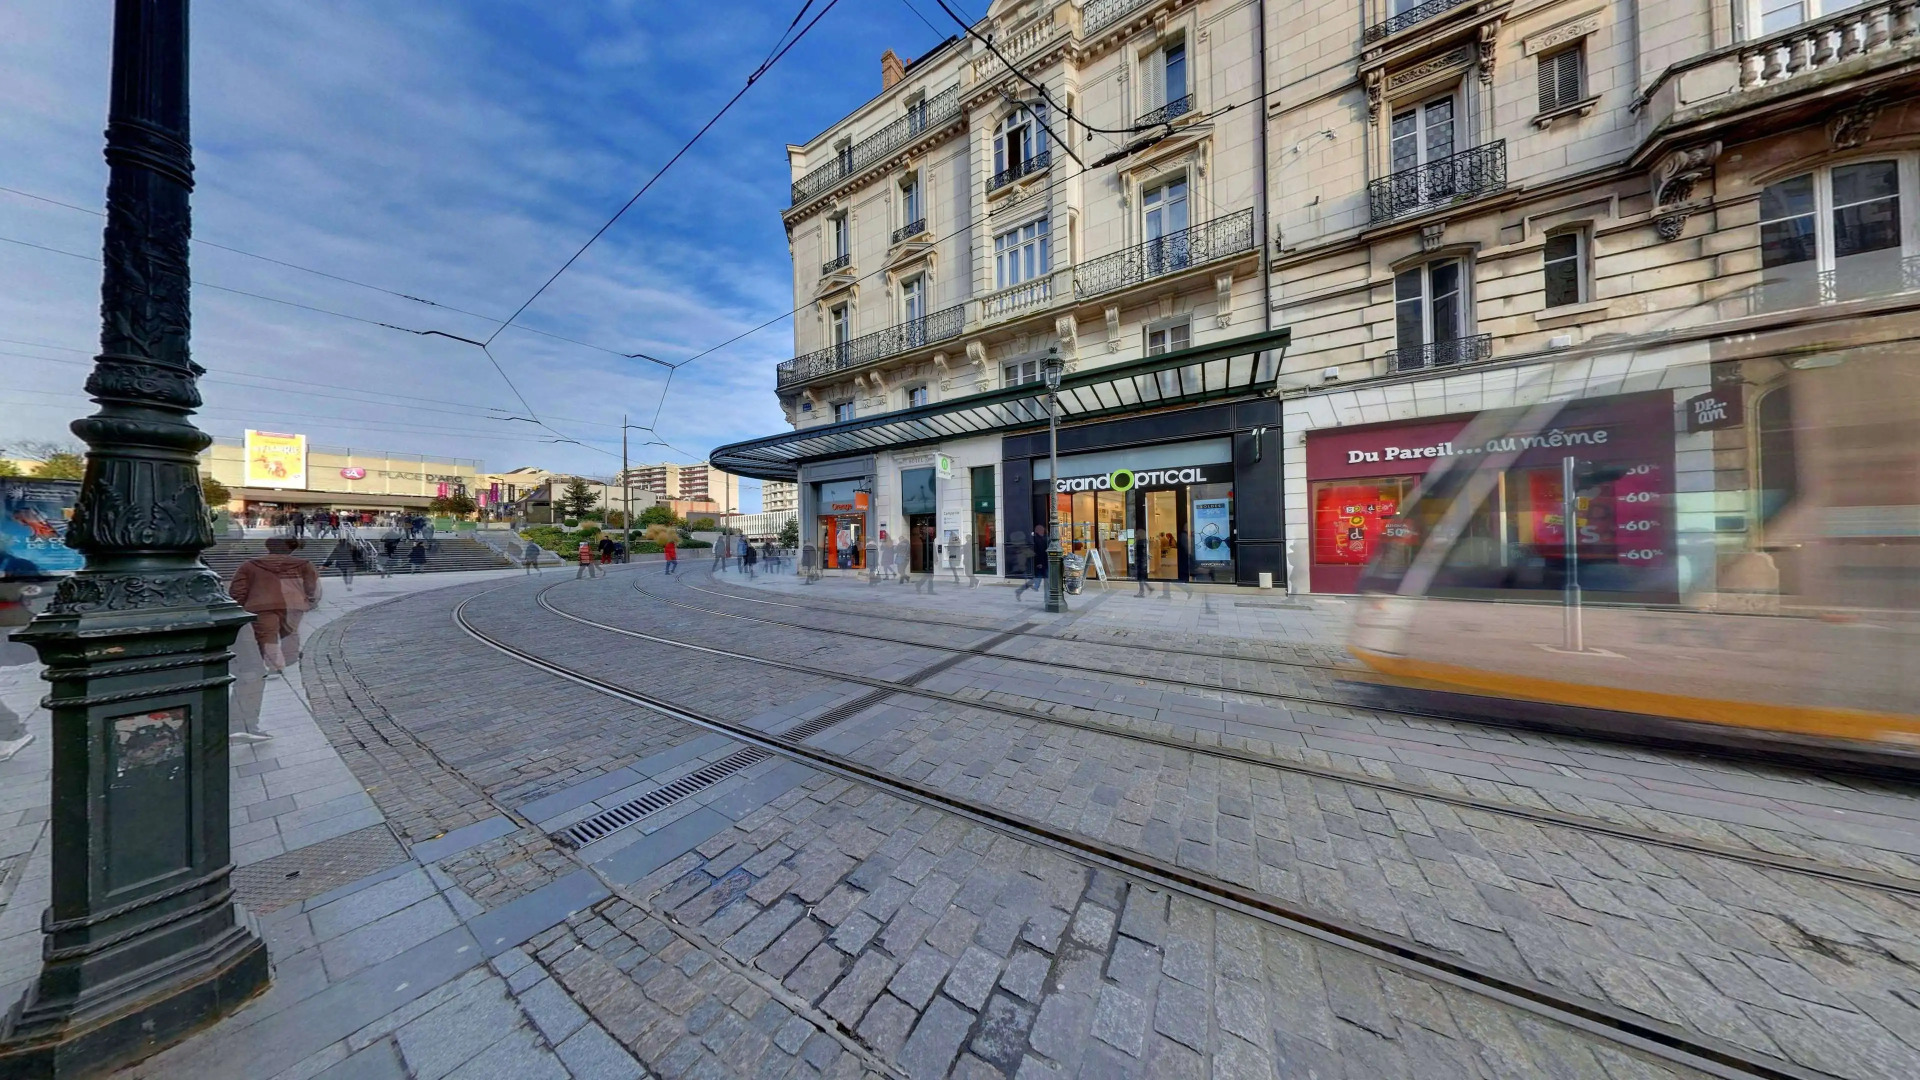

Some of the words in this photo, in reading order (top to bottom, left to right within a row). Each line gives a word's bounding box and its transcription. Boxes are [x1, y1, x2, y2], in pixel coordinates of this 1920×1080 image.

[1698, 408, 1728, 424] am
[1348, 450, 1379, 464] Du
[1486, 435, 1516, 452] au
[1521, 429, 1608, 450] même
[378, 470, 423, 481] PLACE
[425, 474, 463, 484] D'ARC
[1618, 491, 1661, 502] -60%
[1618, 520, 1661, 531] -60%
[1618, 549, 1664, 560] -60%
